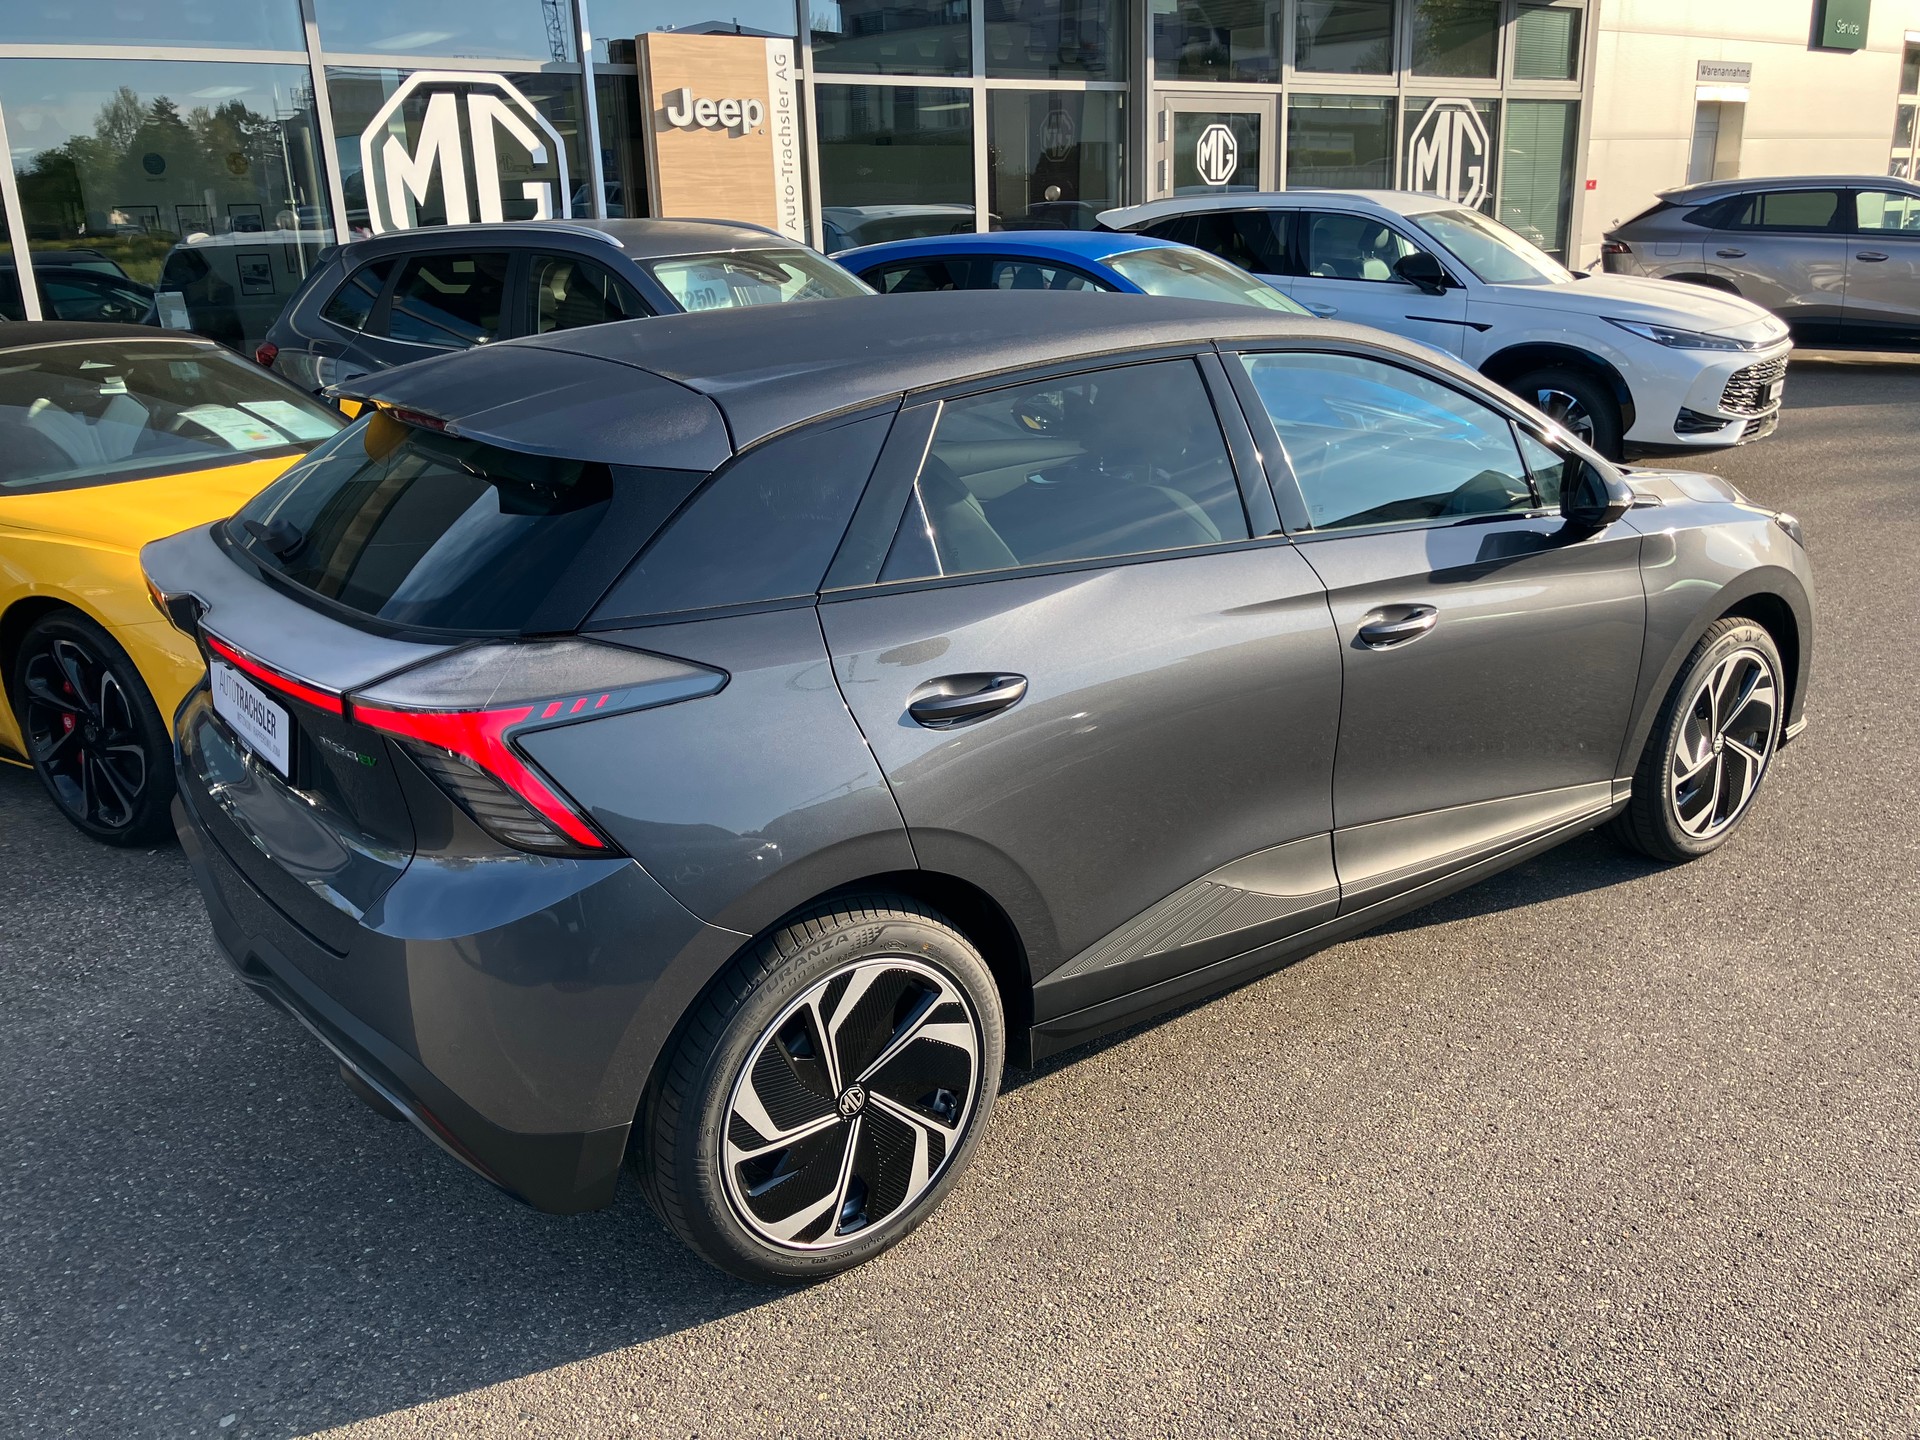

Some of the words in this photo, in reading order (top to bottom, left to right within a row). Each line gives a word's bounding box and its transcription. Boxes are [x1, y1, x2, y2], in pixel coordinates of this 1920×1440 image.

[1836, 19, 1860, 35] Service
[774, 53, 788, 82] AG
[1700, 65, 1750, 78] Warenannahme
[667, 87, 765, 135] Jeep
[382, 92, 553, 230] MG
[776, 89, 798, 231] Auto-Trachsler
[1201, 129, 1234, 180] MG
[1415, 110, 1483, 207] MG
[219, 669, 277, 740] AUTOTRACHSLER
[754, 934, 850, 1003] TURANZA
[841, 1087, 864, 1114] MG
